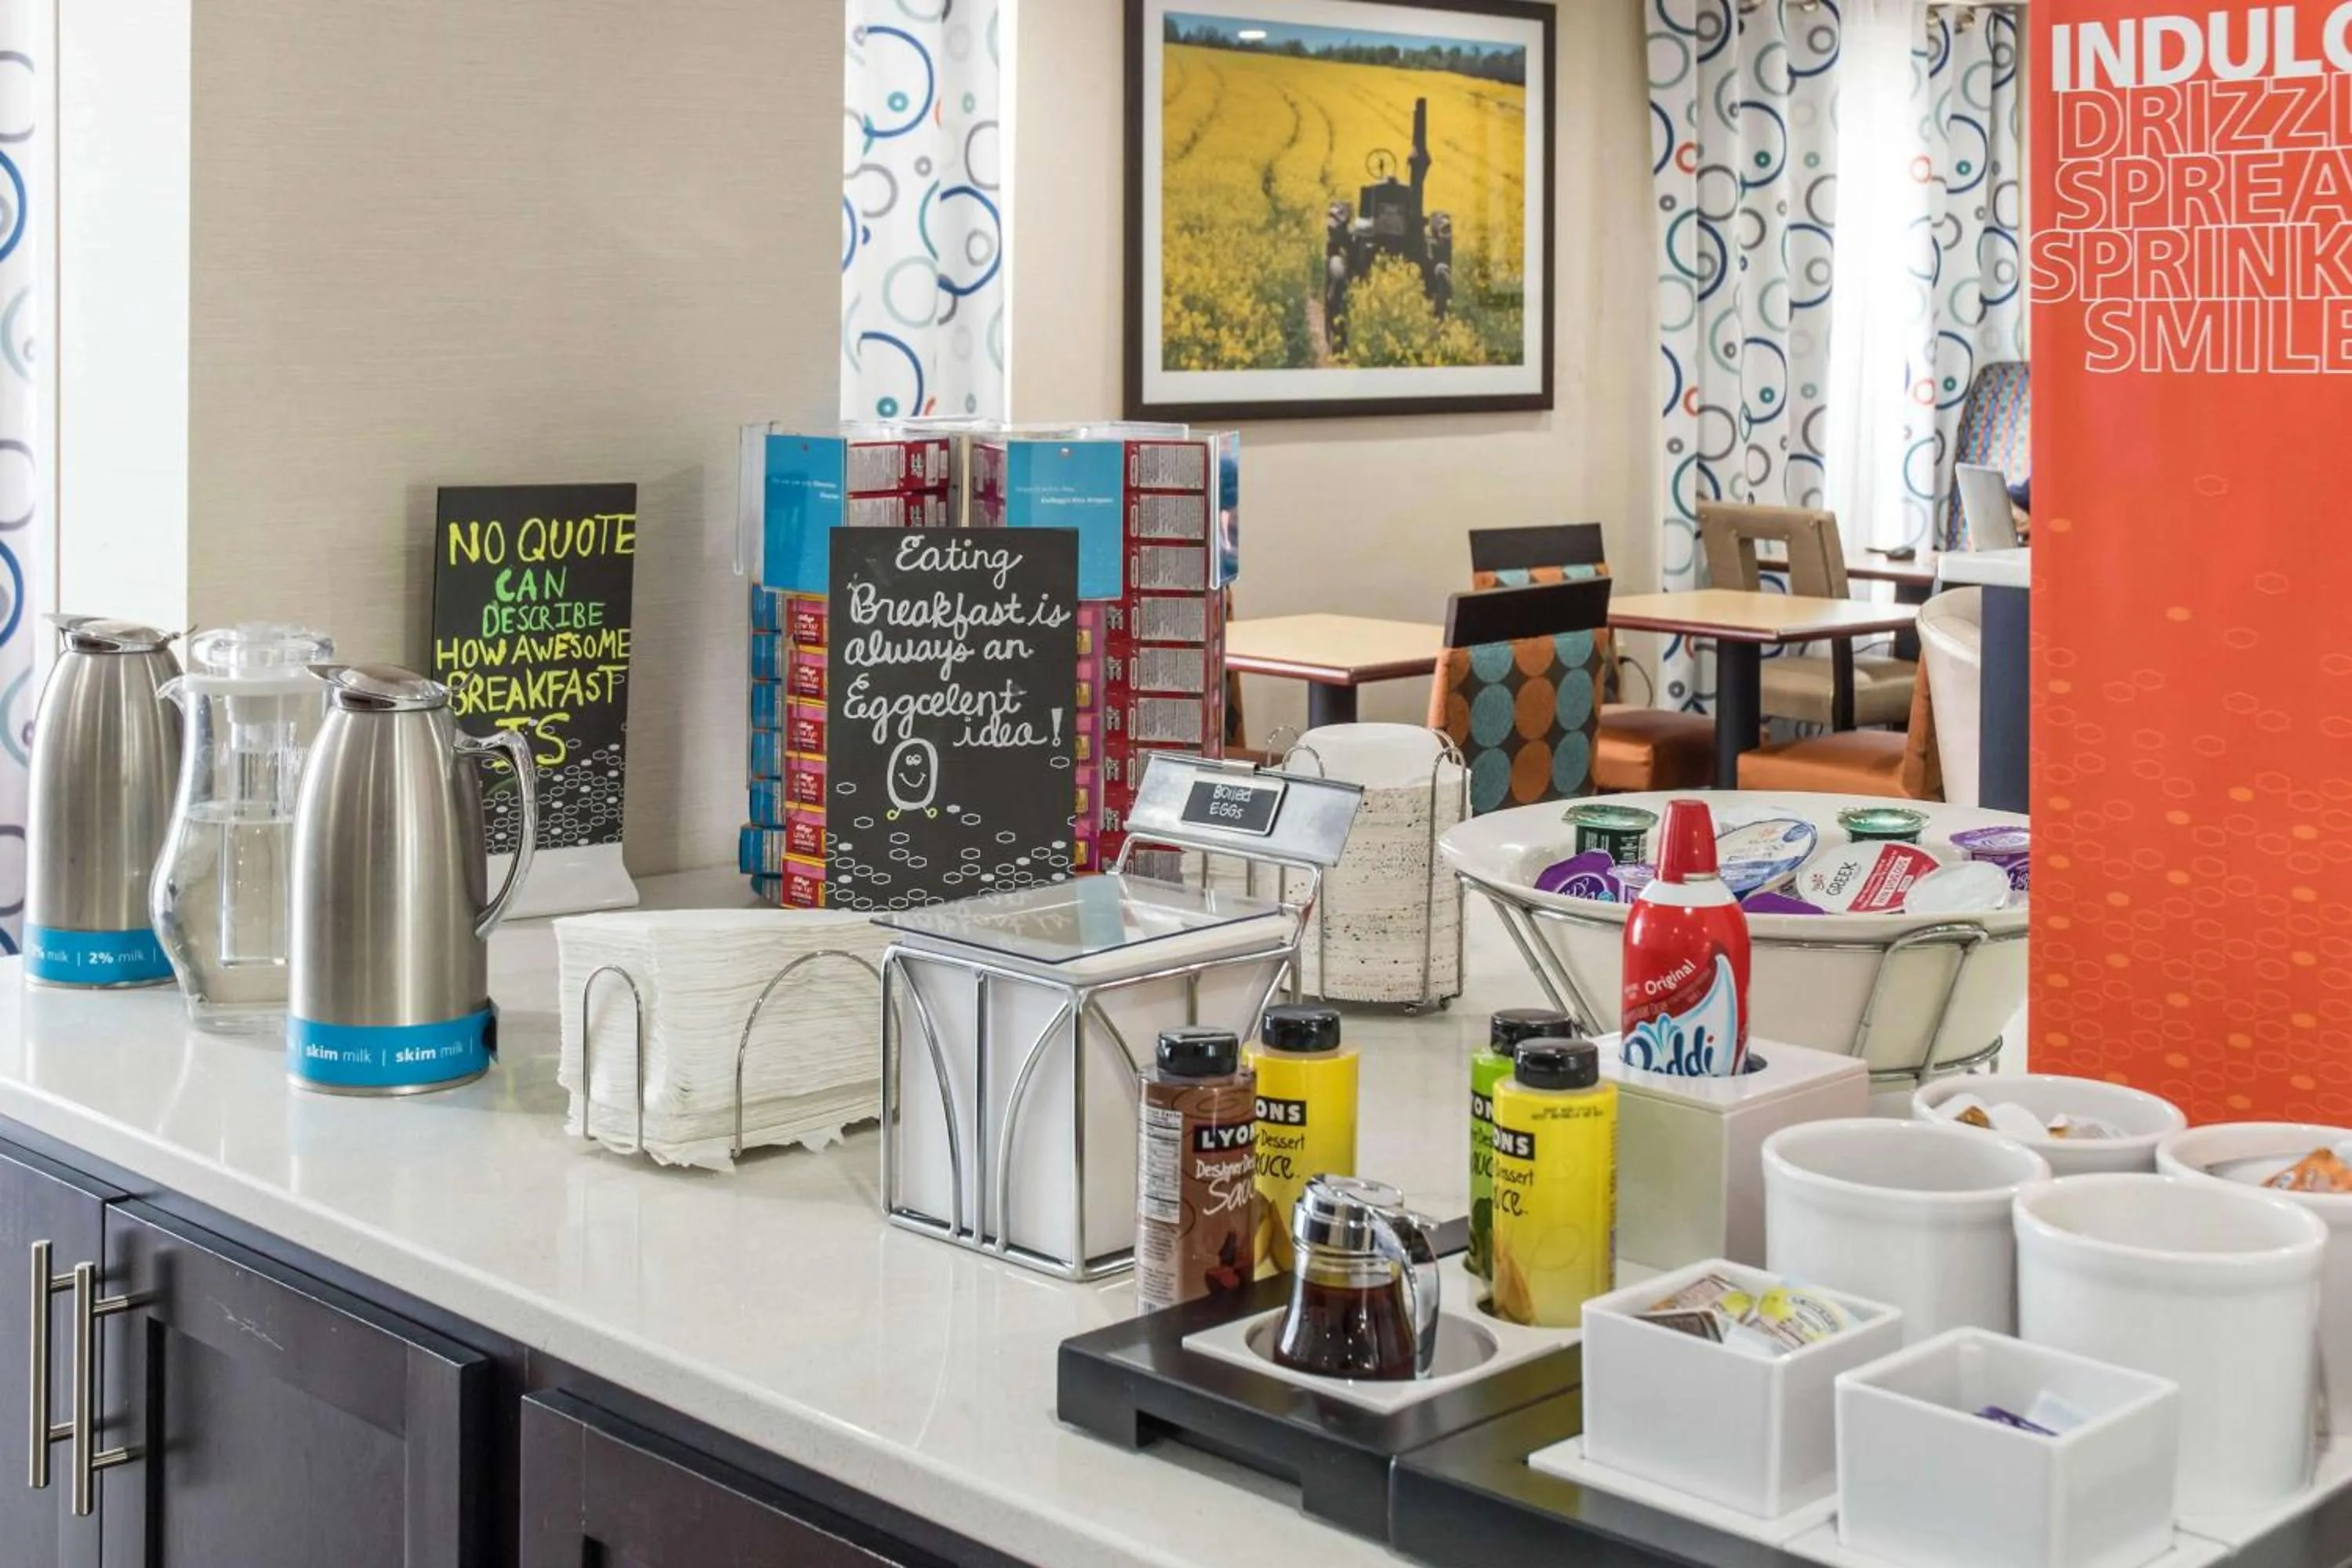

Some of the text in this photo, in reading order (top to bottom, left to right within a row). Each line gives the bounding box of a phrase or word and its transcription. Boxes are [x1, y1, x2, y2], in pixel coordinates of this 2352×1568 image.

[448, 514, 636, 565] NO QUOTE
[895, 535, 1022, 590] Eating
[495, 566, 566, 603] CAN
[482, 602, 606, 638] DESCRIBE
[848, 582, 1025, 641] Breakfast
[1027, 593, 1071, 627] is
[436, 628, 631, 670] HOW AWESOME
[983, 638, 1035, 660] an
[448, 665, 627, 717] BREAKFAST
[89, 952, 114, 964] 2%
[1644, 959, 1697, 996] Original
[305, 1044, 372, 1064] skim milk
[395, 1047, 436, 1063] skim
[1255, 1098, 1301, 1123] ONS
[1201, 1123, 1255, 1149] LYO
[1261, 1129, 1305, 1151] Dessert
[1202, 1178, 1254, 1215] Sau
